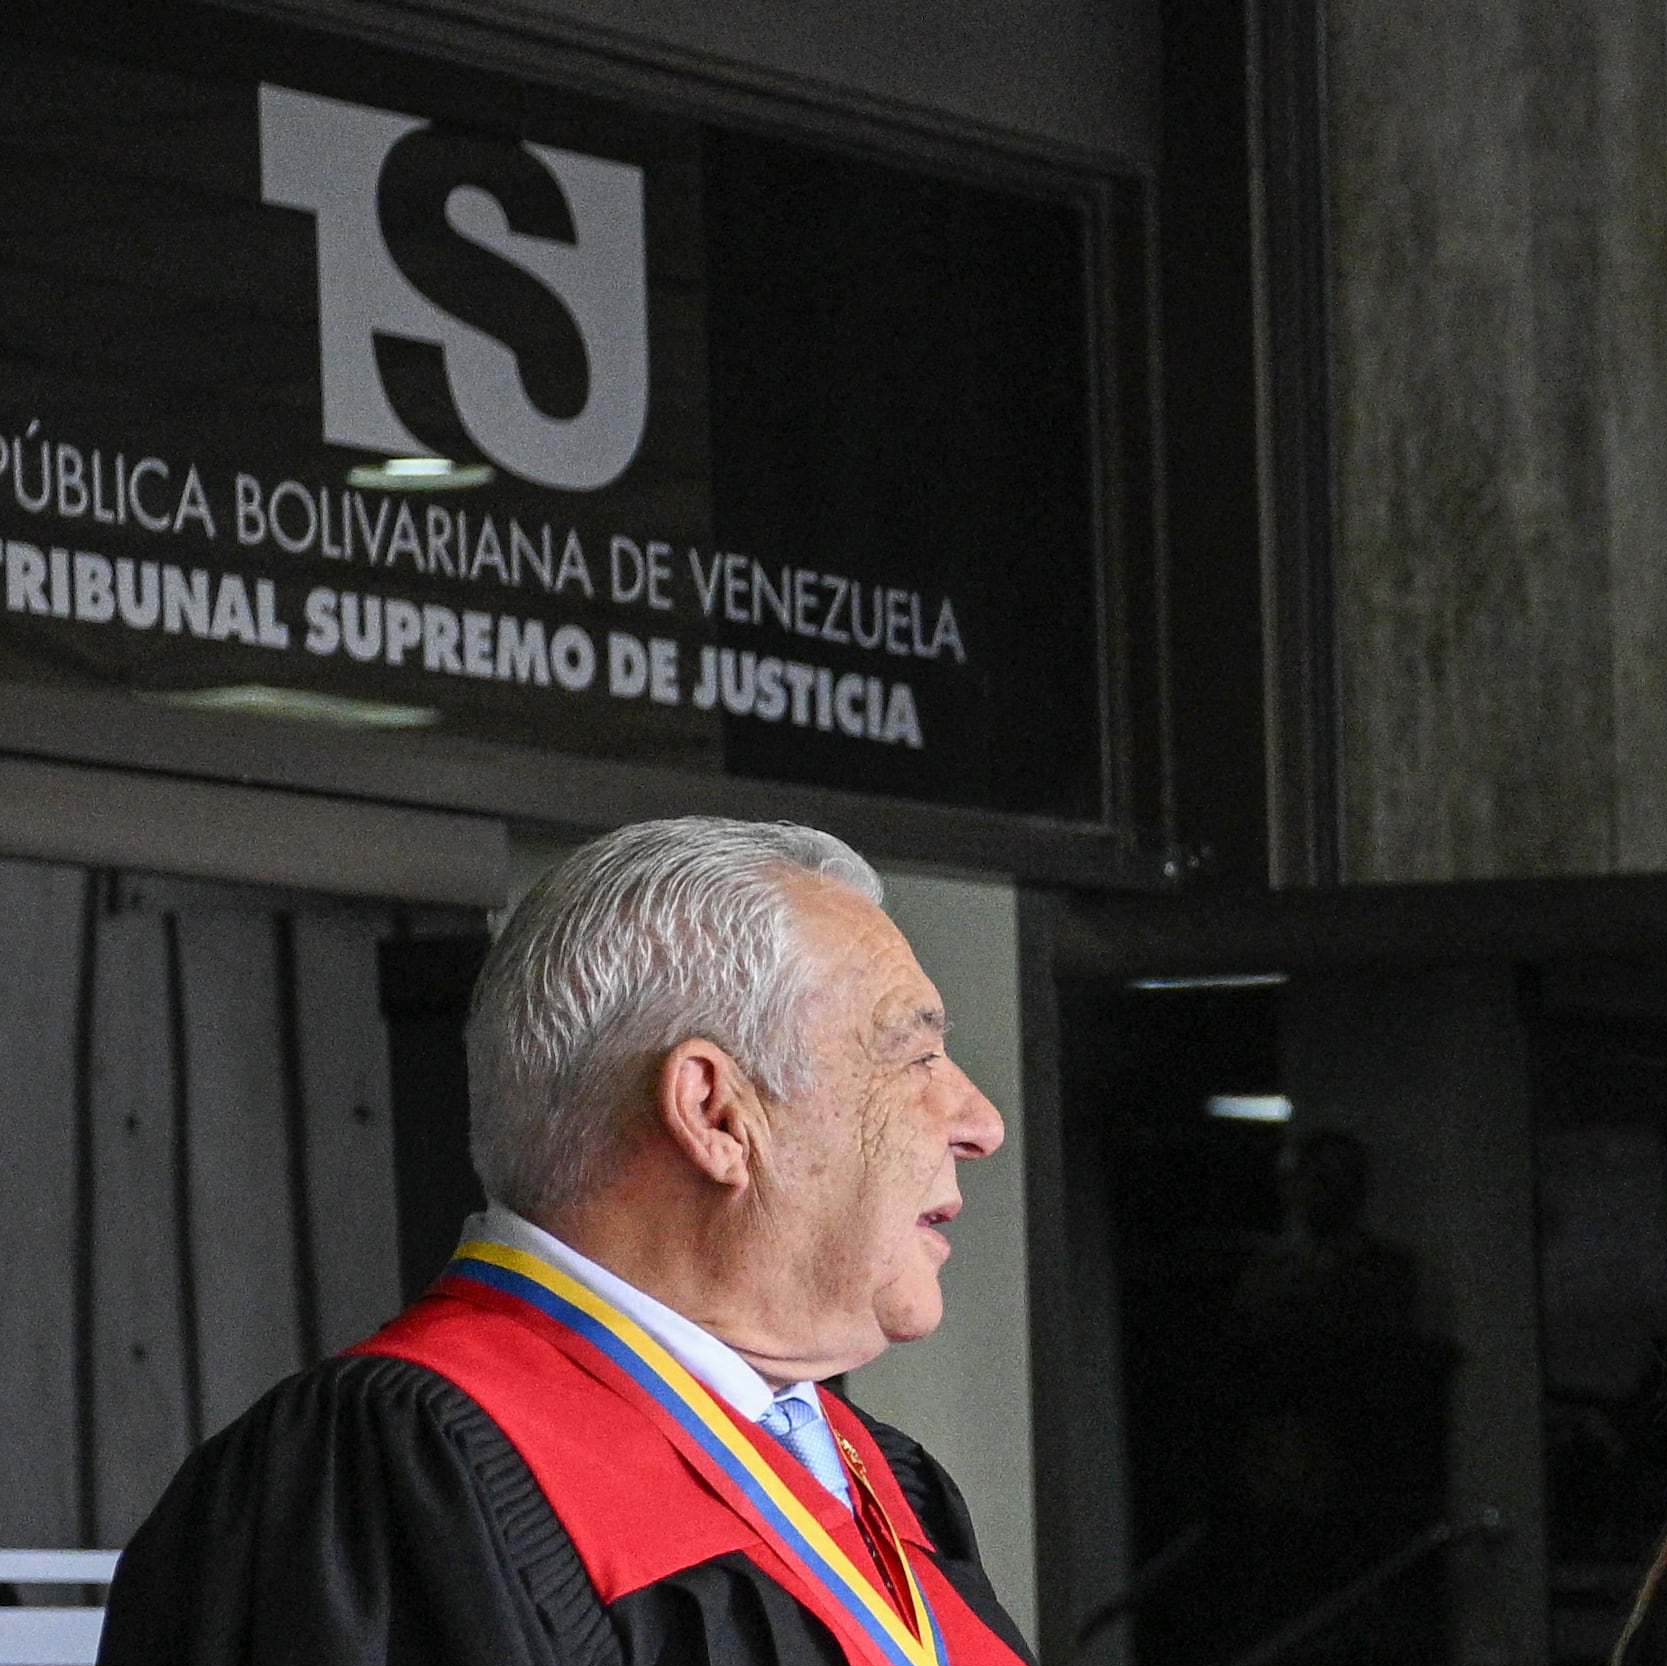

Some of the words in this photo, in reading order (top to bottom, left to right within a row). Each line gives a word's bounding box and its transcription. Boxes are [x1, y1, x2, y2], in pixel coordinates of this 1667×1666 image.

[0, 417, 217, 540] ÚBLICA
[234, 470, 596, 600] BOLIVARIANA
[609, 534, 674, 611] DE
[688, 547, 967, 665] VENEZUELA
[0, 538, 289, 650] RIBUNAL
[303, 585, 596, 691] SUPREMO
[607, 631, 682, 707] DE
[692, 644, 925, 750] JUSTICIA
